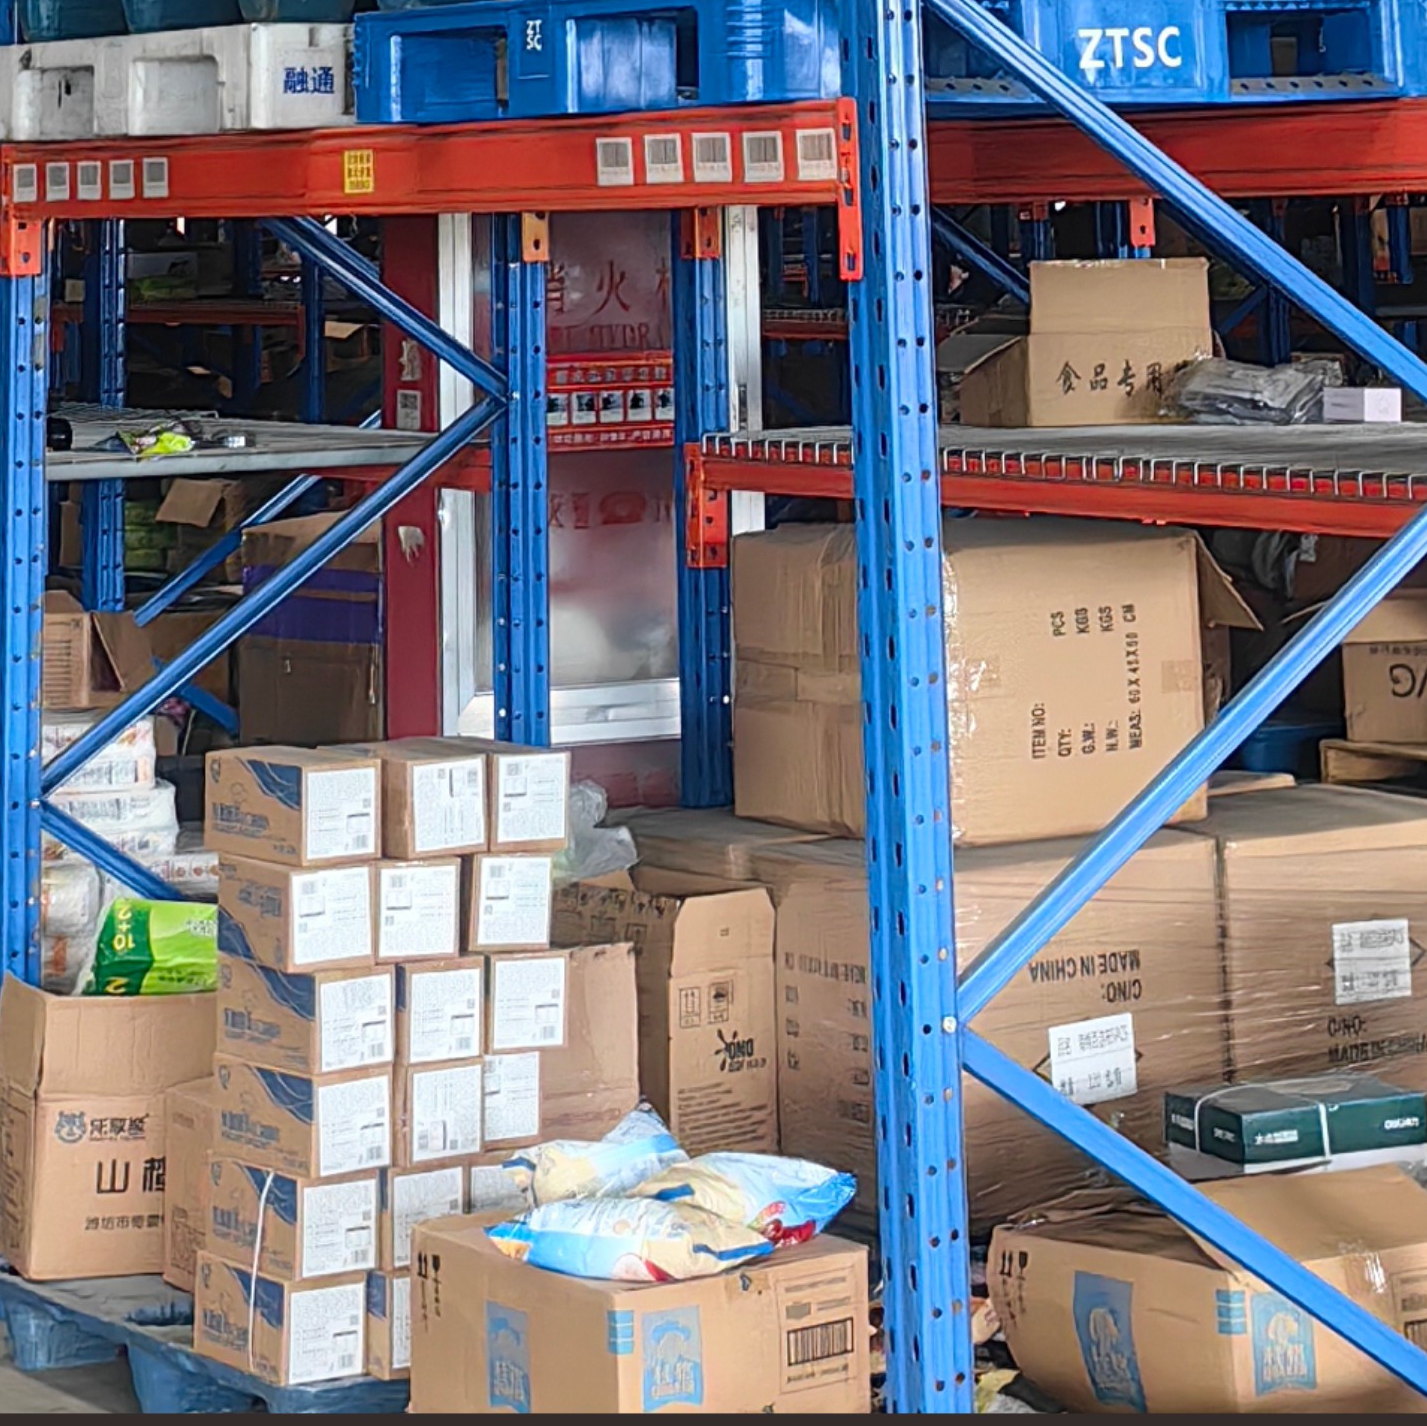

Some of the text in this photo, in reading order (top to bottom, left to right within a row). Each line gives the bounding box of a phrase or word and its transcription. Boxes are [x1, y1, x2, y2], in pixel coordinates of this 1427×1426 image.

[1078, 26, 1183, 71] ZTSC
[282, 66, 337, 97] 融通
[1055, 360, 1166, 395] 食品专用
[1098, 605, 1114, 632] KGS
[1122, 603, 1137, 623] CM
[1050, 610, 1072, 757] QTY: PCS
[1031, 702, 1047, 759] ITEM NO:
[1028, 949, 1141, 983] MADE IN CHINA
